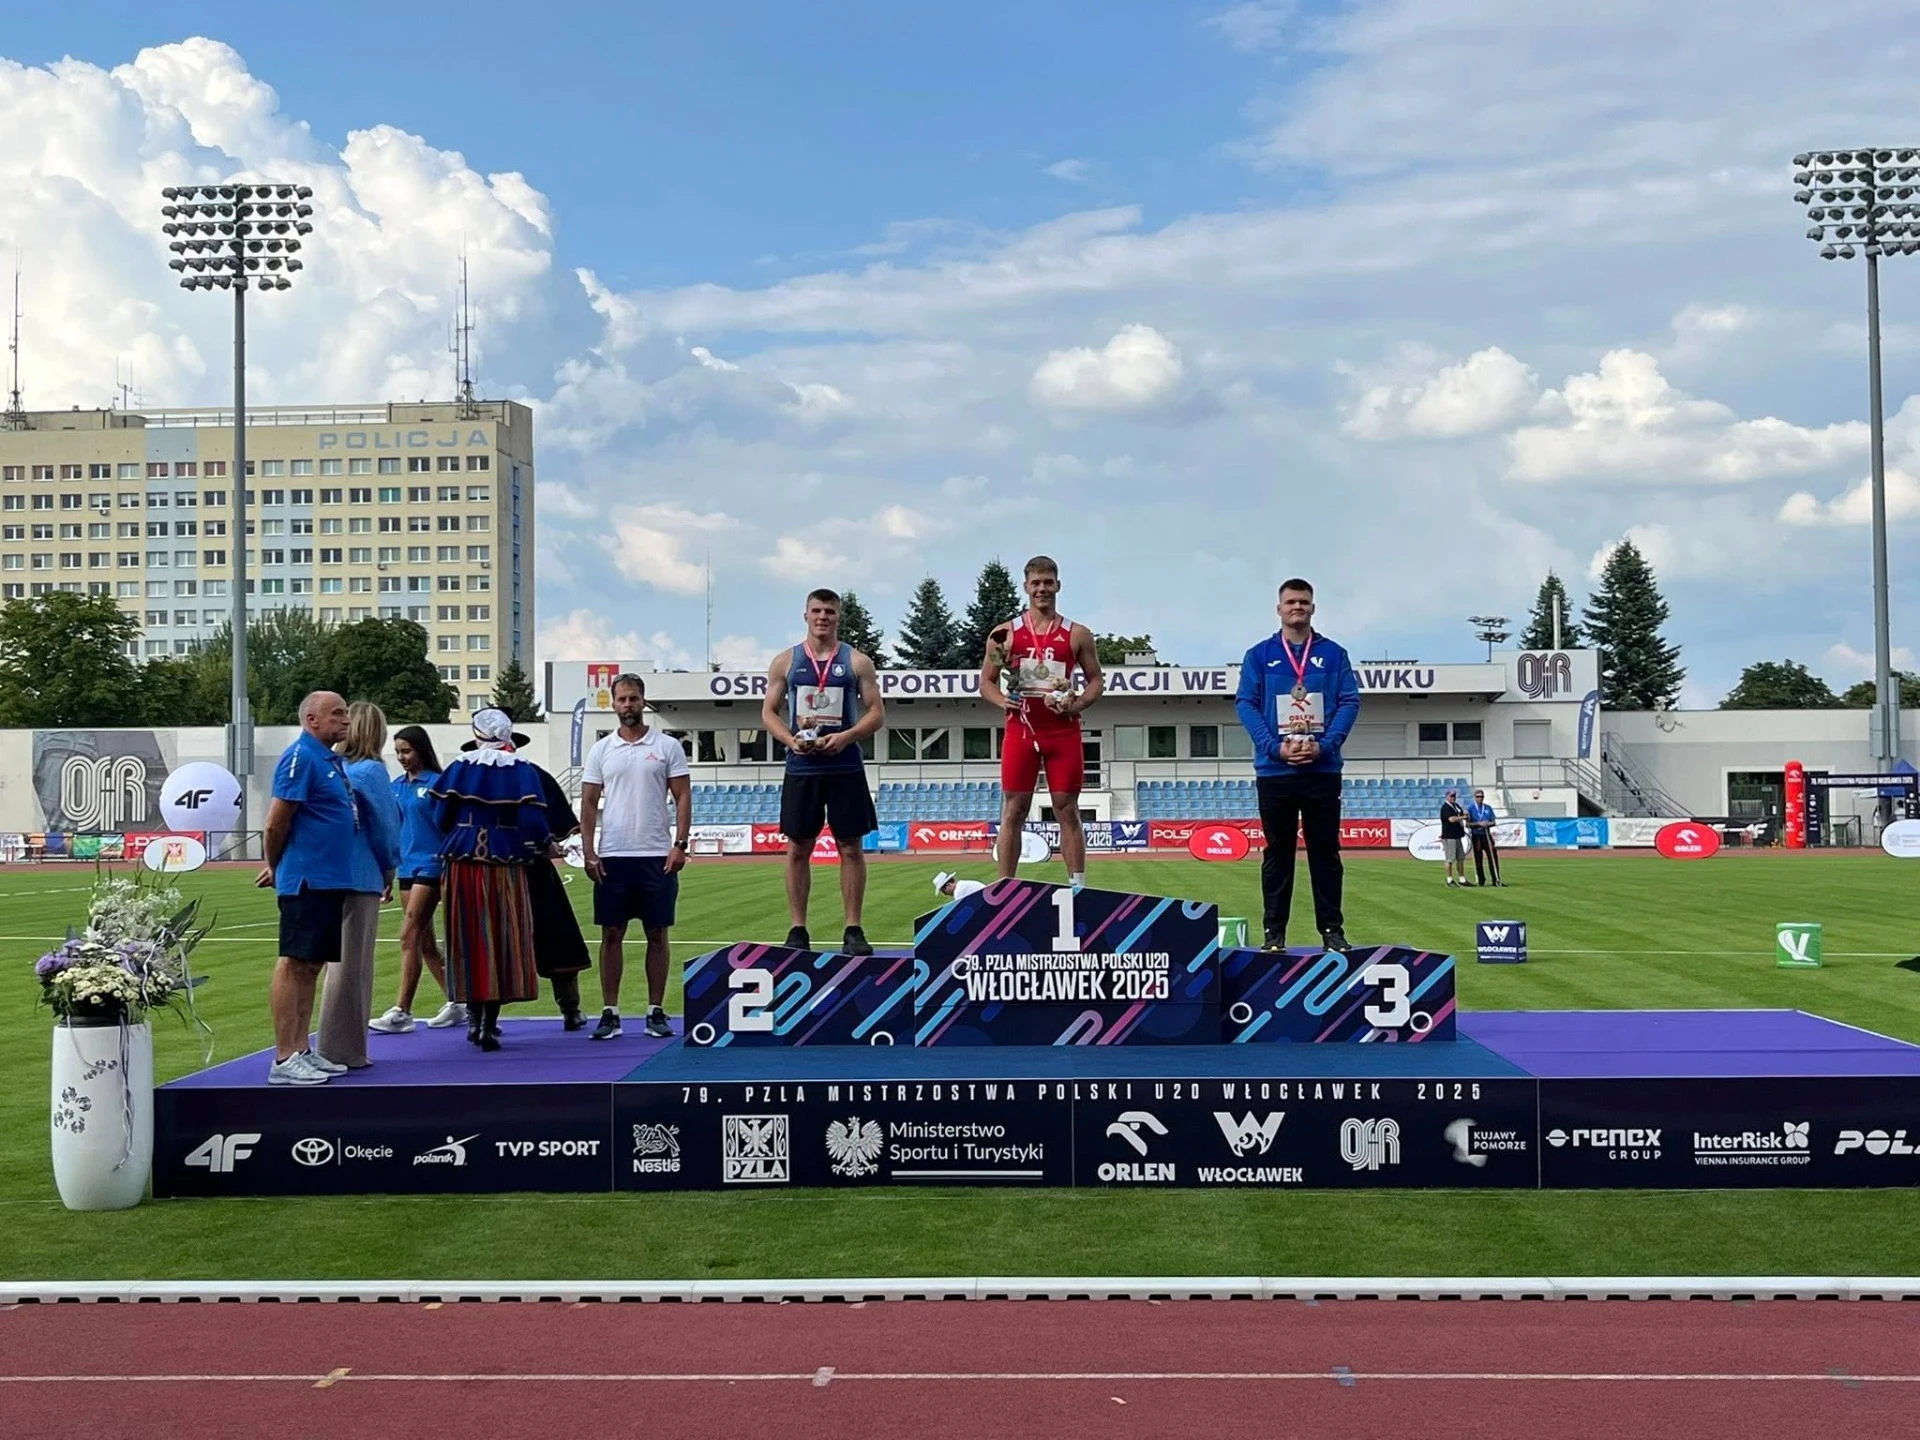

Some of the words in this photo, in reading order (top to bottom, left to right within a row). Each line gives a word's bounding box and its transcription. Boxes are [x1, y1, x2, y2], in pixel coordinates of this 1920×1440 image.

[319, 430, 488, 449] POLICJA
[1026, 647, 1055, 660] 76
[876, 674, 980, 694] PORTU
[1182, 671, 1227, 691] WE
[174, 790, 214, 809] 4F
[939, 829, 983, 841] ORLEN
[1087, 832, 1112, 846] 2025
[1052, 888, 1081, 952] 1
[966, 955, 984, 971] 79.
[986, 955, 1014, 971] PZLA
[1016, 954, 1099, 971] MISTRZOSTWA
[1102, 953, 1143, 970] POLSKI
[1146, 952, 1169, 969] U20
[966, 971, 1106, 1001] WŁOCŁAWEK
[1112, 970, 1169, 1000] 2025
[727, 968, 775, 1032] 2
[1363, 964, 1411, 1027] 3
[682, 1086, 722, 1103] 79.
[745, 1086, 805, 1103] PZLA
[828, 1084, 1015, 1102] MISTRZOSTWA
[1038, 1083, 1132, 1101] POLSKI
[1155, 1083, 1200, 1100] U20
[1223, 1083, 1381, 1100] WŁOCŁAWEK
[1417, 1083, 1481, 1100] 2025
[889, 1121, 1006, 1139] Ministerstwo
[1473, 1131, 1517, 1141] KUJAWY
[1573, 1128, 1662, 1148] renex
[495, 1141, 534, 1158] TVP
[538, 1140, 600, 1157] SPORT
[1473, 1141, 1527, 1151] POMORZE
[1694, 1131, 1783, 1149] InterRisk
[1834, 1130, 1920, 1155] POL
[184, 1133, 262, 1172] 4F
[344, 1145, 394, 1161] Okęcie
[413, 1151, 455, 1166] polanik
[889, 1144, 949, 1162] Sportu
[953, 1143, 960, 1160] i
[964, 1143, 1044, 1162] Turystyki
[1608, 1150, 1662, 1160] GROUP
[1694, 1157, 1727, 1166] VIENNA
[1729, 1156, 1779, 1166] INSURANCE
[1780, 1155, 1811, 1165] GROUP
[726, 1160, 787, 1180] PZLA
[1098, 1163, 1176, 1182] ORLEN
[1198, 1167, 1303, 1183] WŁOCŁAWEK
